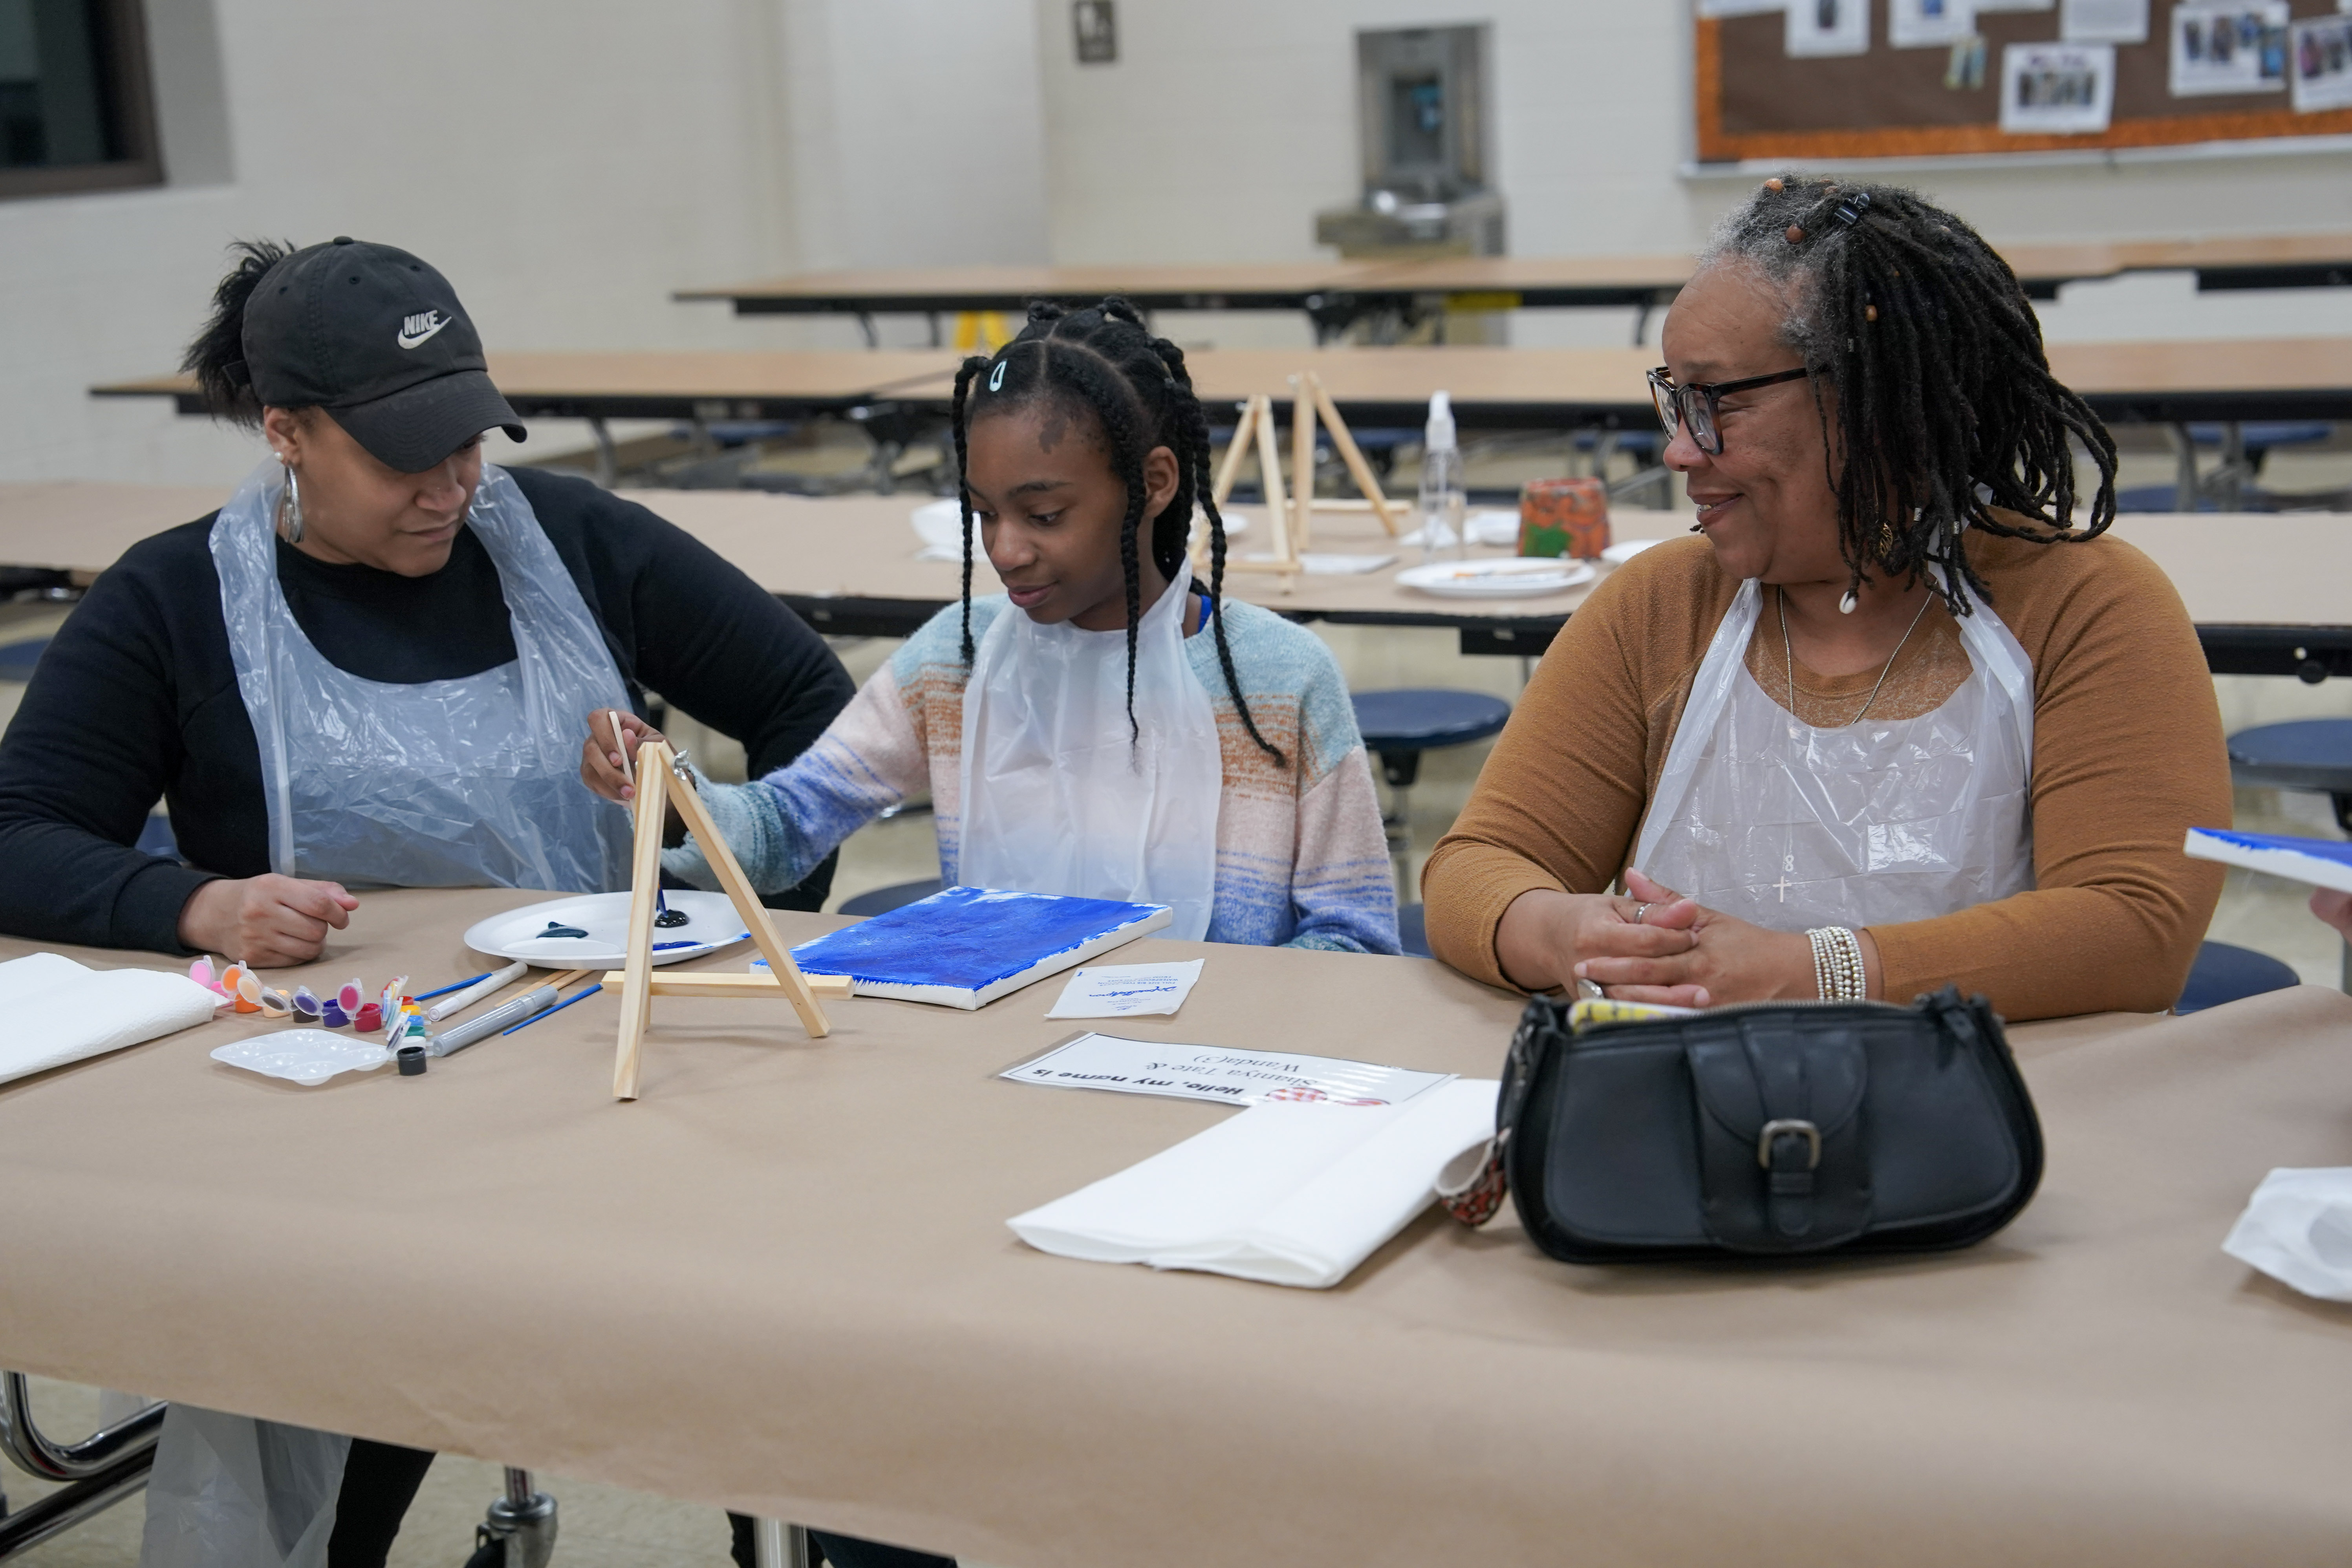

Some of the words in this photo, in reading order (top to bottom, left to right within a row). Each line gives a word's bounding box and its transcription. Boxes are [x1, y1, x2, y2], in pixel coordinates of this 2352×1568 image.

[404, 309, 440, 336] NIKE
[1144, 1062, 1168, 1070] &
[1193, 1054, 1300, 1072] Wanda(3)
[1171, 1065, 1217, 1076] Tate
[1059, 1072, 1128, 1083] name
[1133, 1077, 1173, 1087] my
[1226, 1070, 1318, 1087] Shaniya
[1181, 1081, 1245, 1095] Hello,
